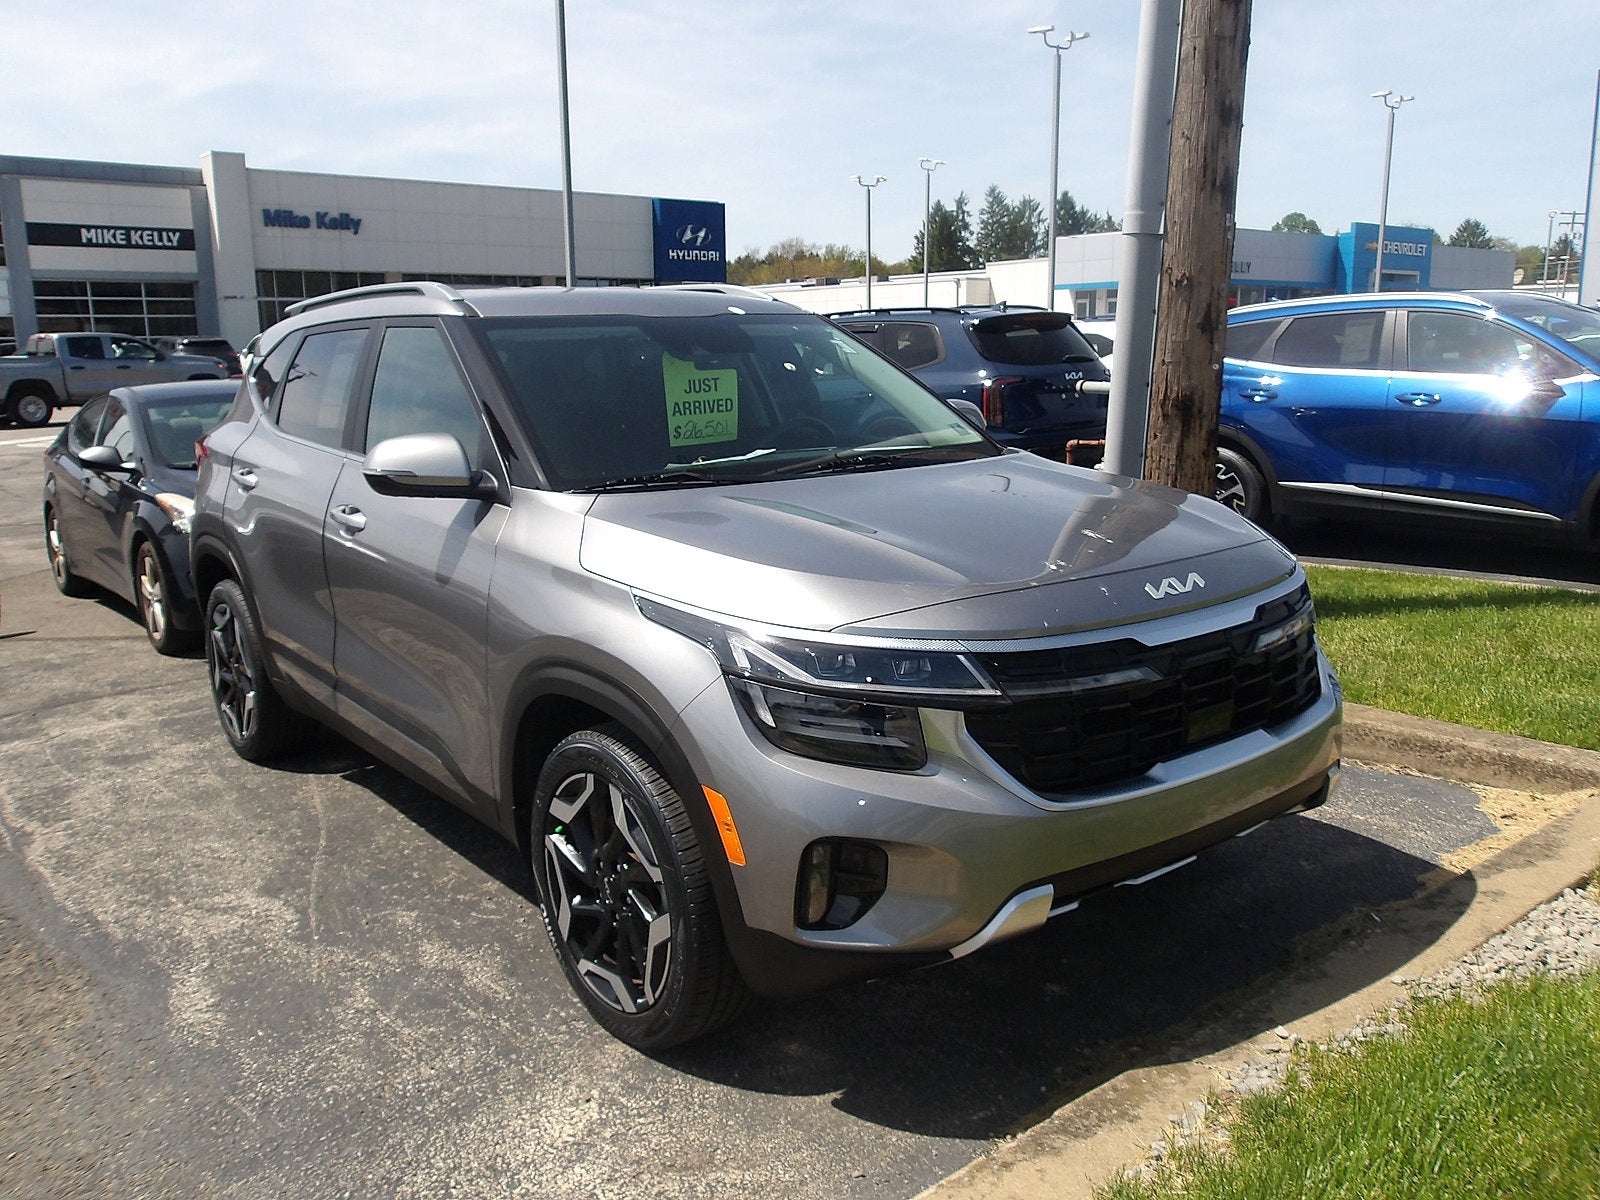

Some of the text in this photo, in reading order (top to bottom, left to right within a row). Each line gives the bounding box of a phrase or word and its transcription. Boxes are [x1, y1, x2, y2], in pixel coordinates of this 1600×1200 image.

[262, 208, 362, 236] Mike Kelly
[80, 227, 180, 247] MIKE KELLY
[668, 248, 720, 262] HYUNDAI
[1382, 240, 1427, 257] CHEVROLET
[683, 377, 720, 394] JUST
[672, 398, 734, 417] ARRIVED
[1143, 572, 1206, 600] KIA
